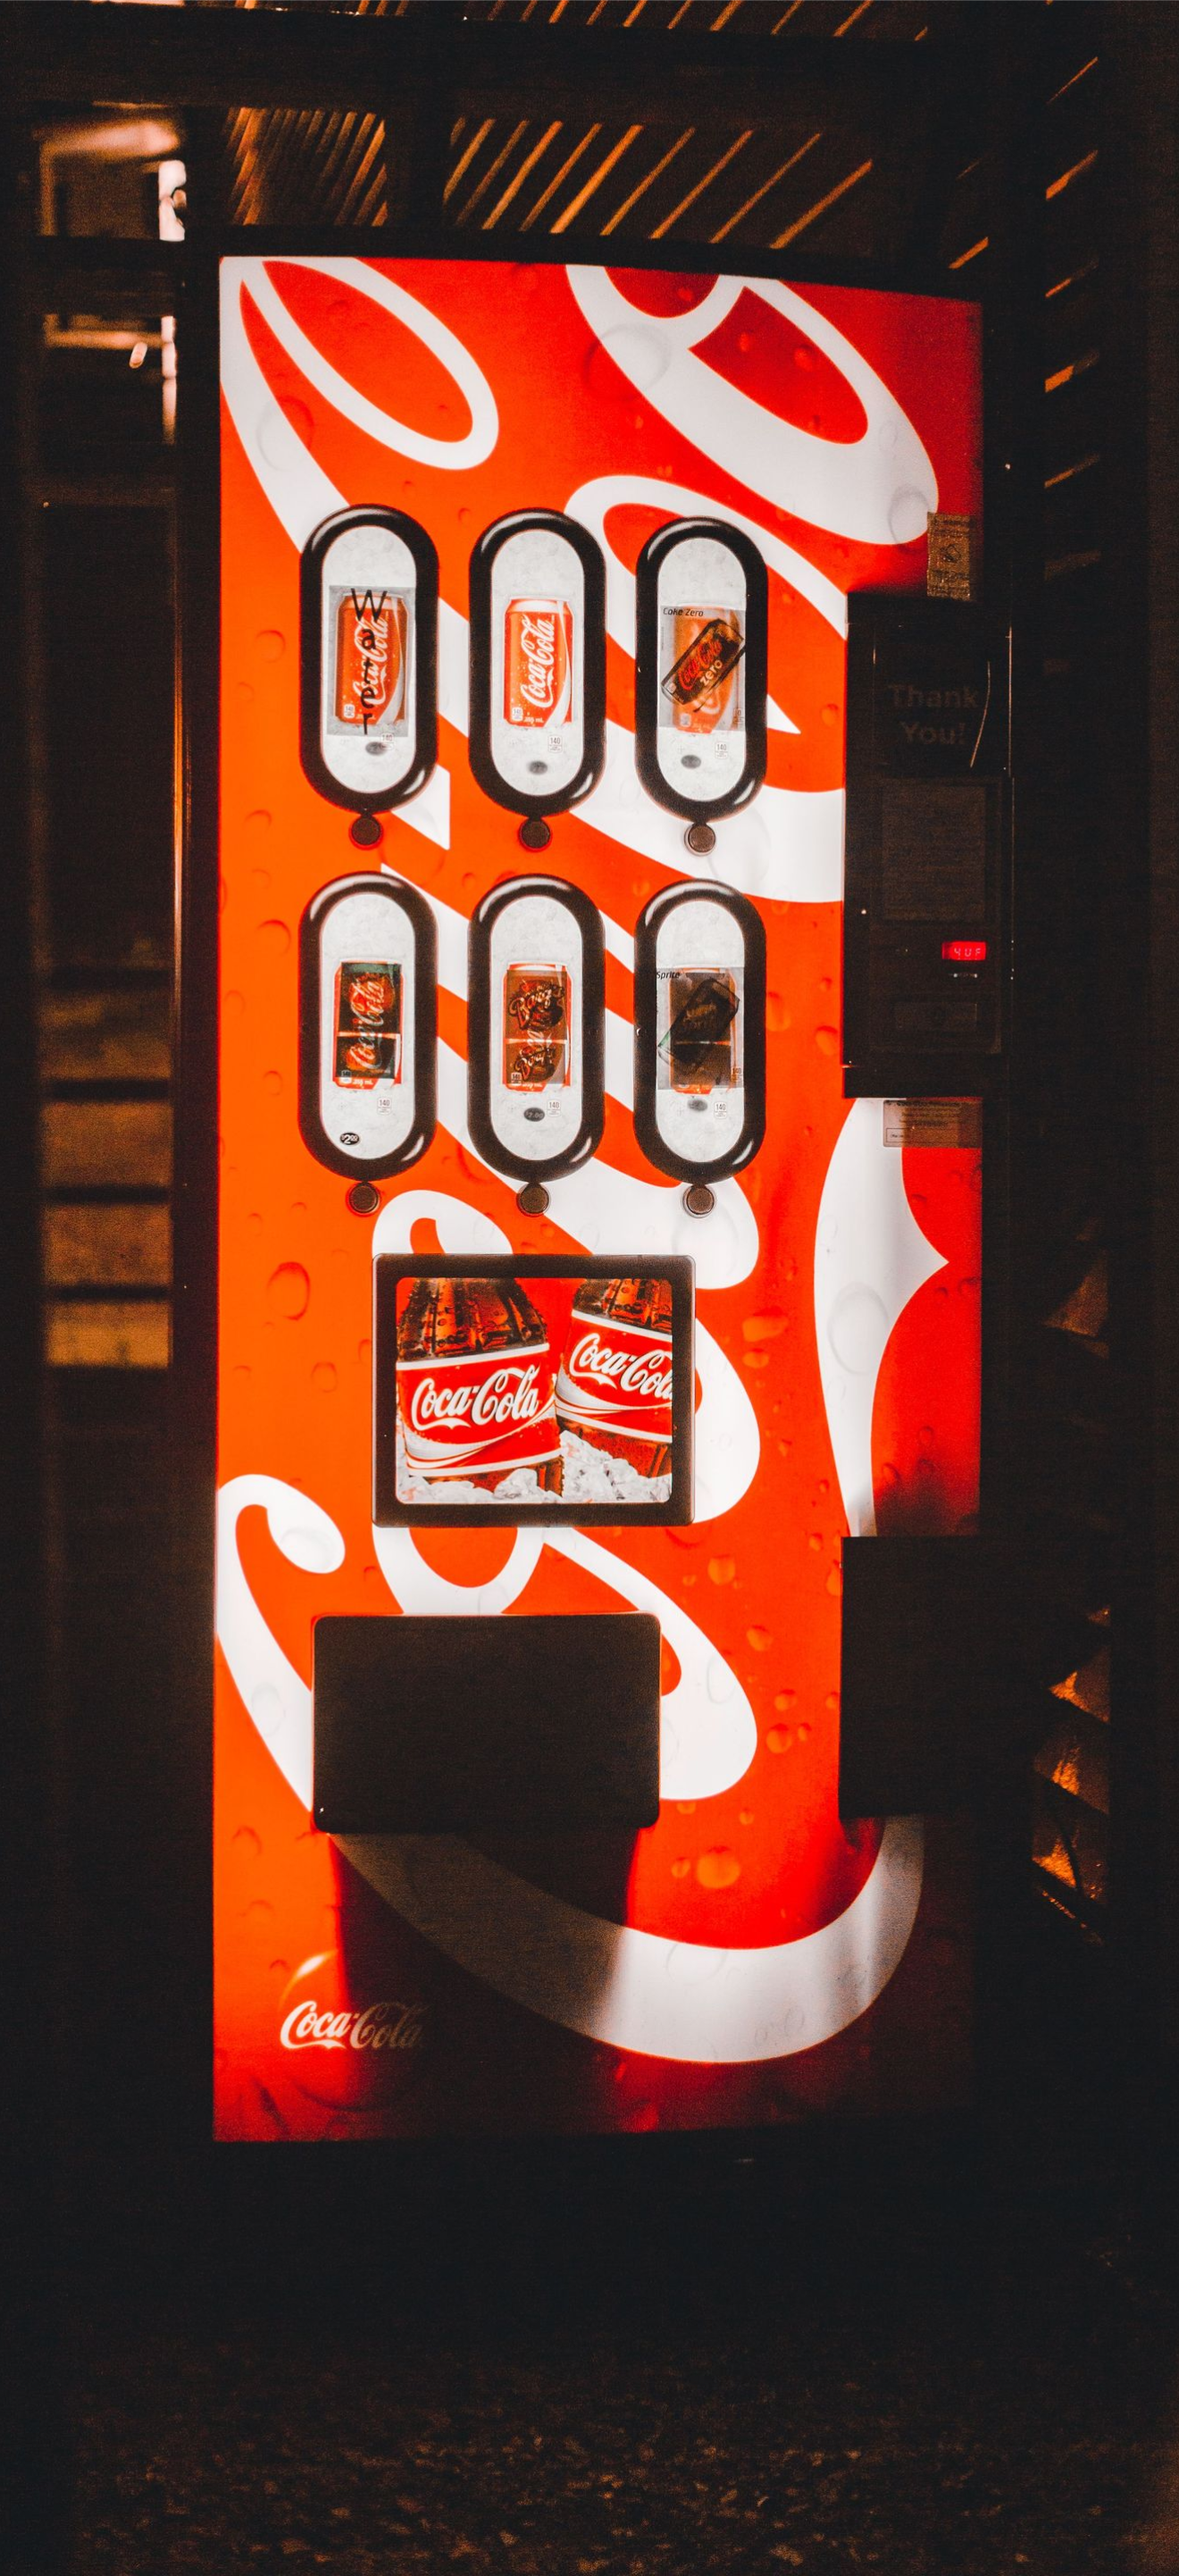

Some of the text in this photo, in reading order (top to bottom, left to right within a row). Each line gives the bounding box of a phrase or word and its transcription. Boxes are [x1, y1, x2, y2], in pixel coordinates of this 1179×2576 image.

[663, 607, 704, 617] Coke Zero
[350, 588, 389, 735] Water
[520, 614, 555, 708] Coca-Cola
[699, 659, 723, 687] zero
[887, 683, 978, 708] Thank
[899, 720, 966, 745] You!
[656, 970, 681, 980] Sprite
[411, 1365, 540, 1431] Coca-Cola
[280, 2001, 428, 2050] Coca-Cola
